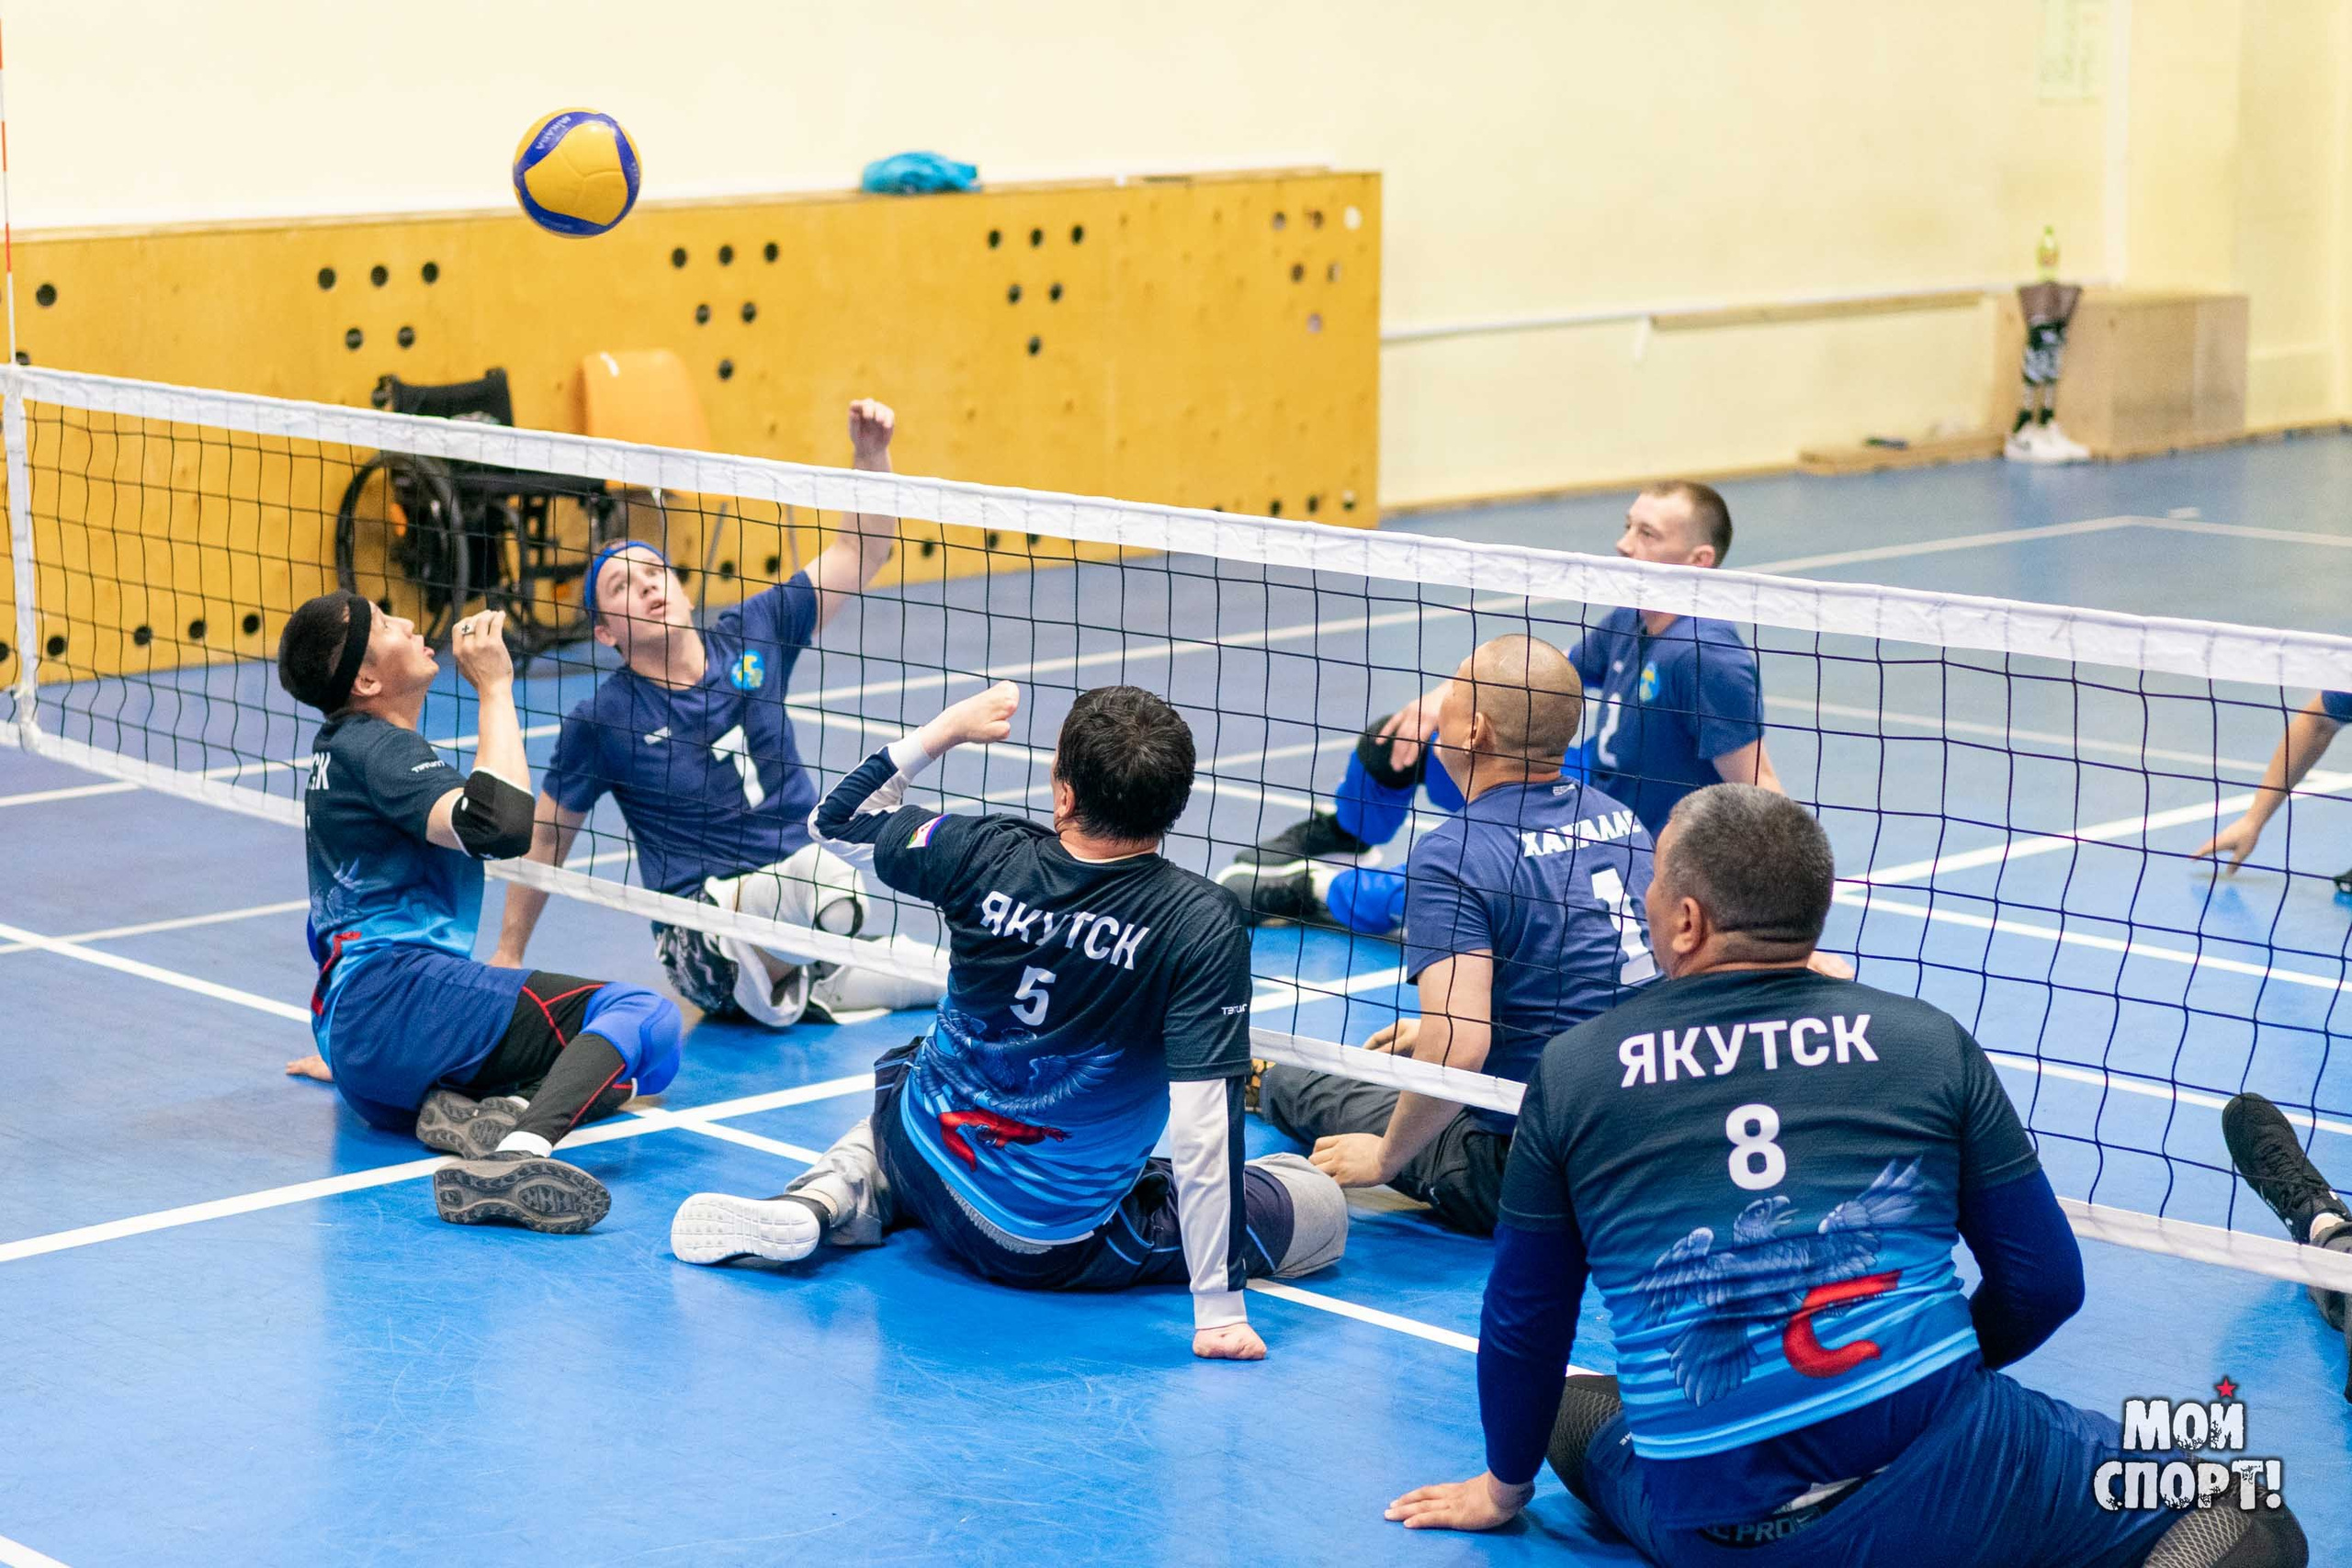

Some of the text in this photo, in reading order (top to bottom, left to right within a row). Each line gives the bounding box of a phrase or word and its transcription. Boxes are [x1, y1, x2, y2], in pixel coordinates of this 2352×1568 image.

[710, 724, 765, 809] 1
[980, 890, 1150, 971] ЯКУТСК
[1010, 965, 1057, 1027] 5
[1618, 1014, 1880, 1089] ЯКУТСК
[1725, 1103, 1787, 1191] 8
